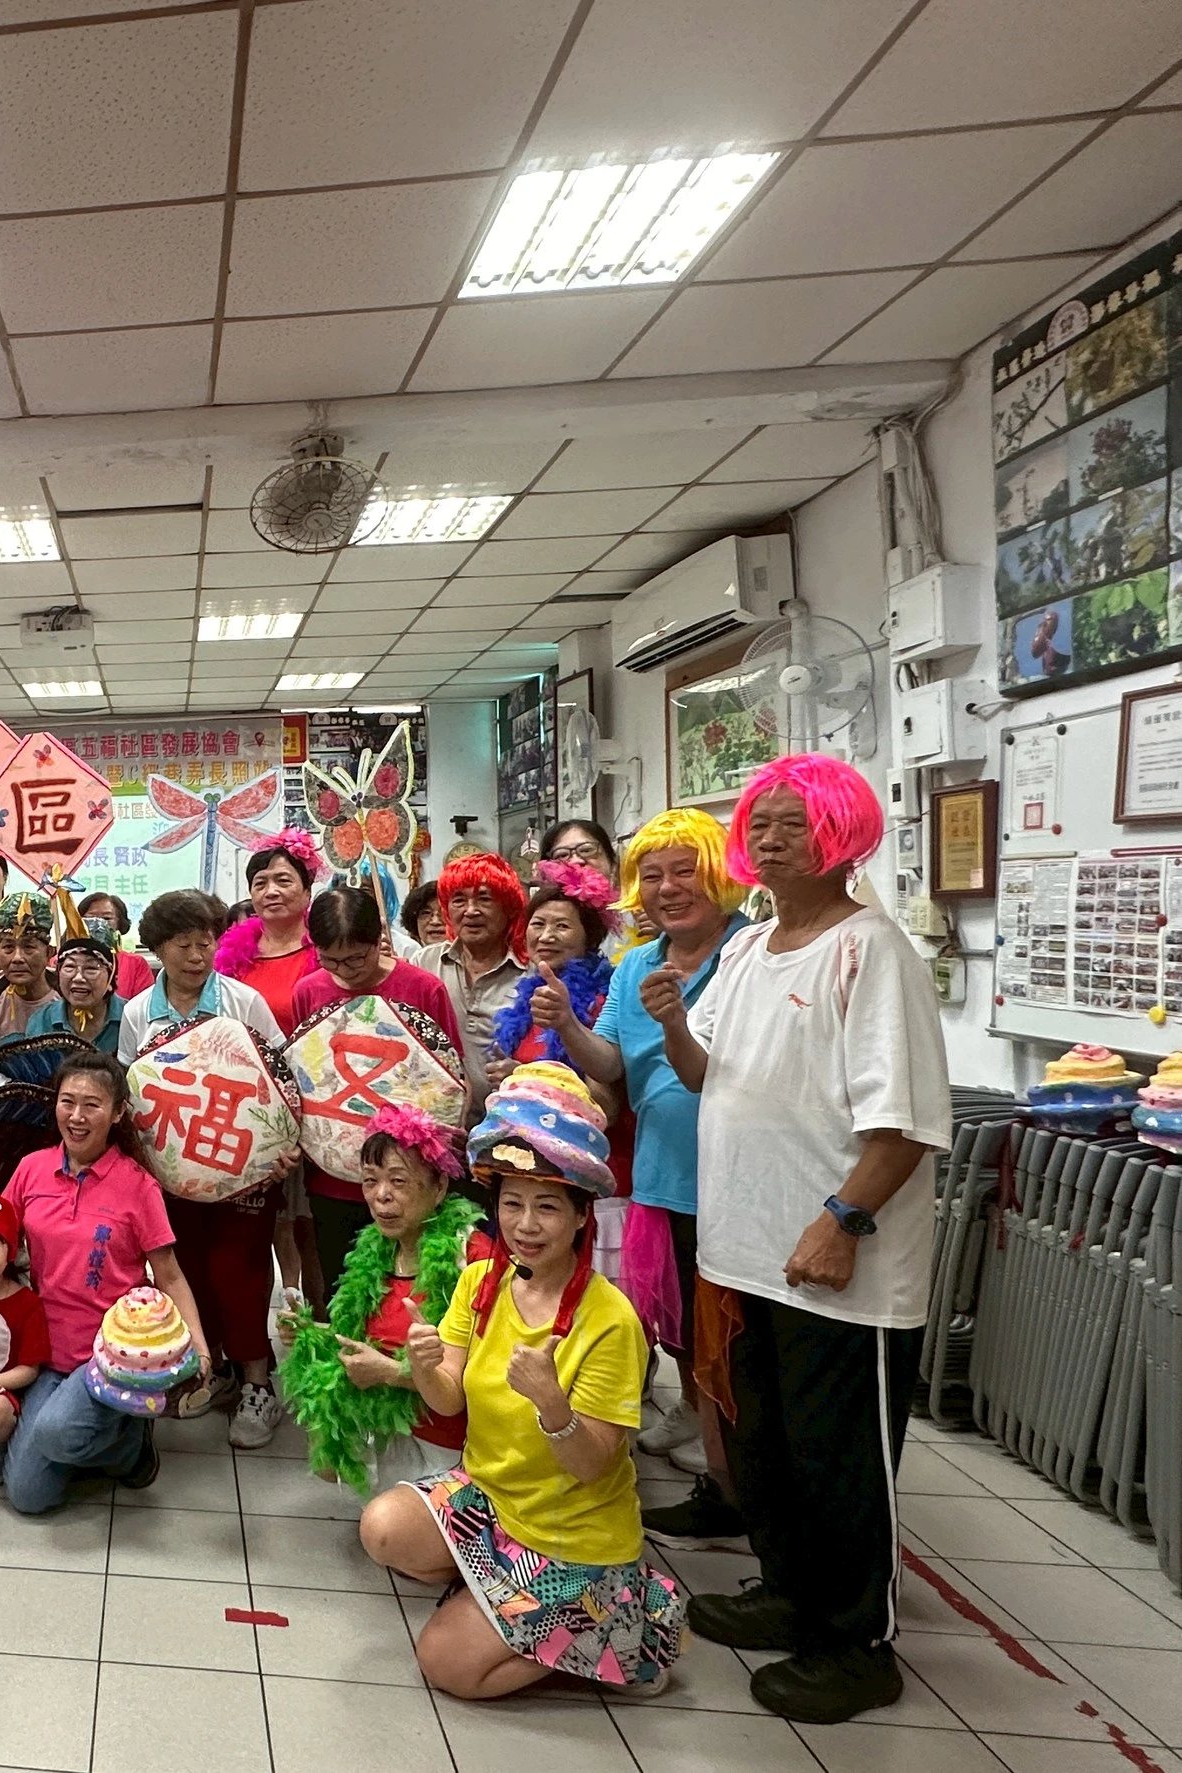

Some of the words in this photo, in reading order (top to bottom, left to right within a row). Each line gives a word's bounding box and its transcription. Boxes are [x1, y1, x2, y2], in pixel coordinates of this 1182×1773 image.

[93, 760, 271, 787] 暨C級巷弄長照站
[11, 778, 85, 855] 區
[114, 846, 148, 867] 賢政
[115, 873, 149, 895] 主任
[133, 1066, 258, 1177] 福
